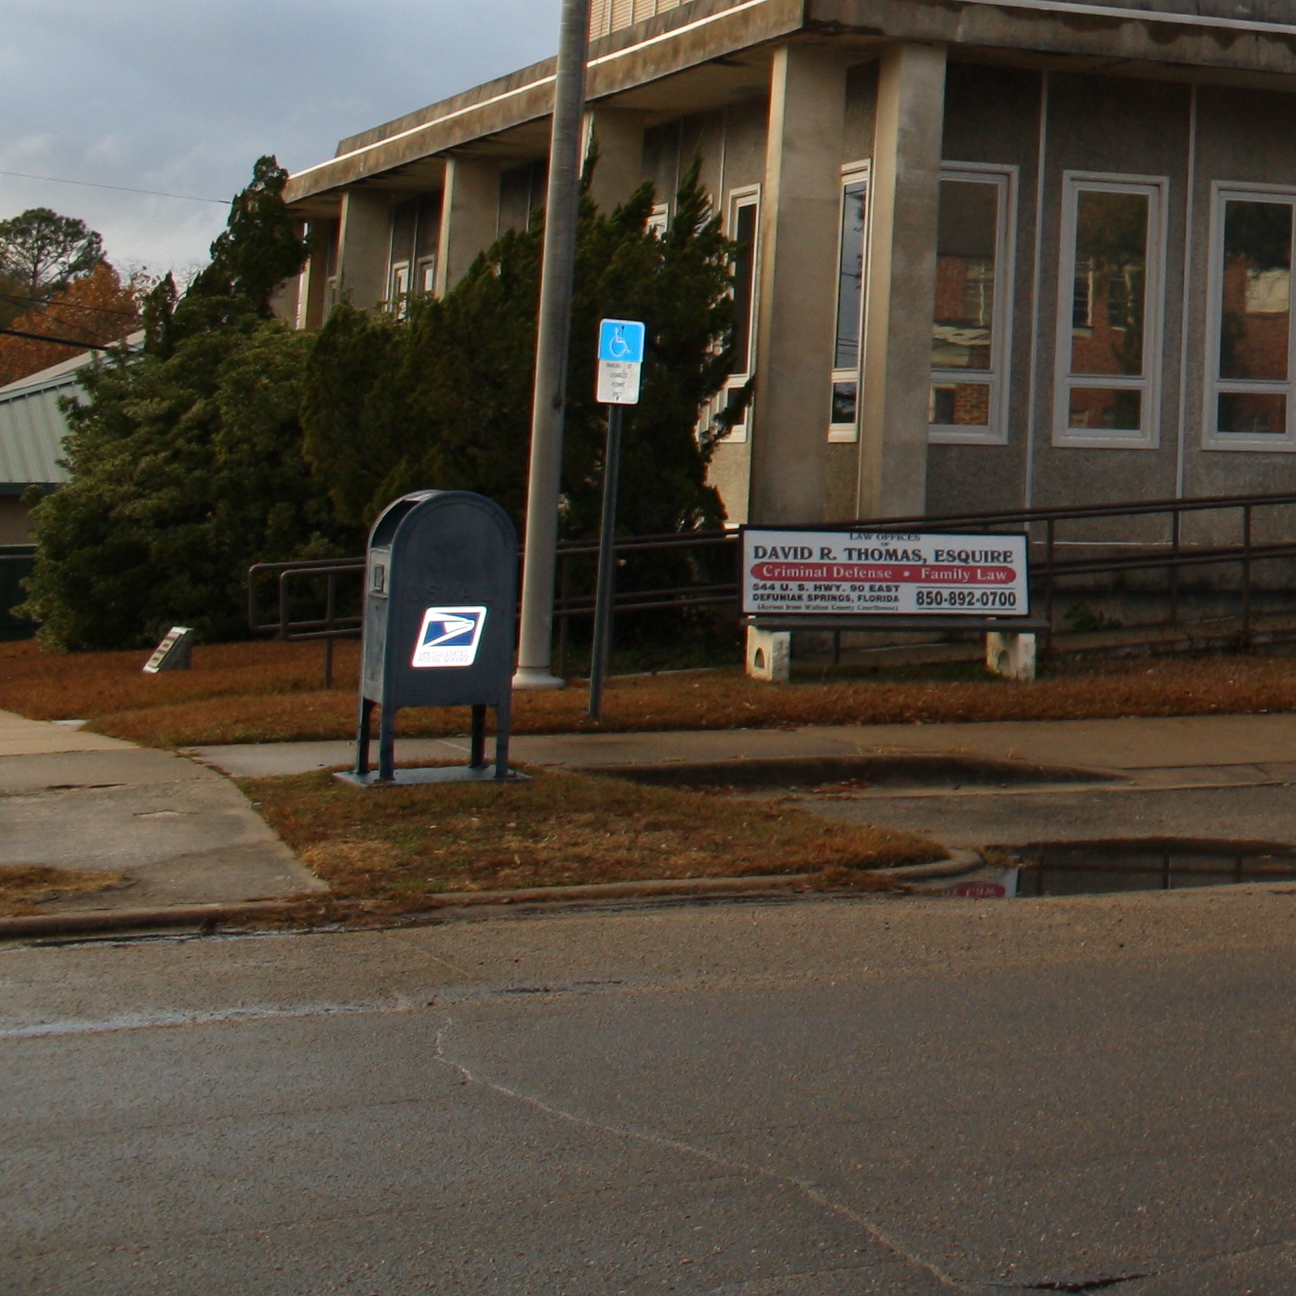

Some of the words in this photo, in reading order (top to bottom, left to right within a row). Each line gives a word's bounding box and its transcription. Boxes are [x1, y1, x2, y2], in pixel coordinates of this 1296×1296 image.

[753, 545, 813, 560] DAVID
[819, 548, 837, 561] R.
[843, 547, 927, 564] THOMAS,
[934, 549, 1014, 564] ESQUIRE
[762, 565, 827, 578] Criminal
[833, 567, 892, 579] Defense
[921, 567, 971, 582] Family
[976, 569, 1008, 580] Law
[869, 584, 901, 594] EAST
[752, 593, 804, 602] DEFUNIAK
[807, 594, 854, 604] SPRINGS,
[857, 595, 901, 603] FLORIDA
[916, 590, 1016, 607] 850-892-0700
